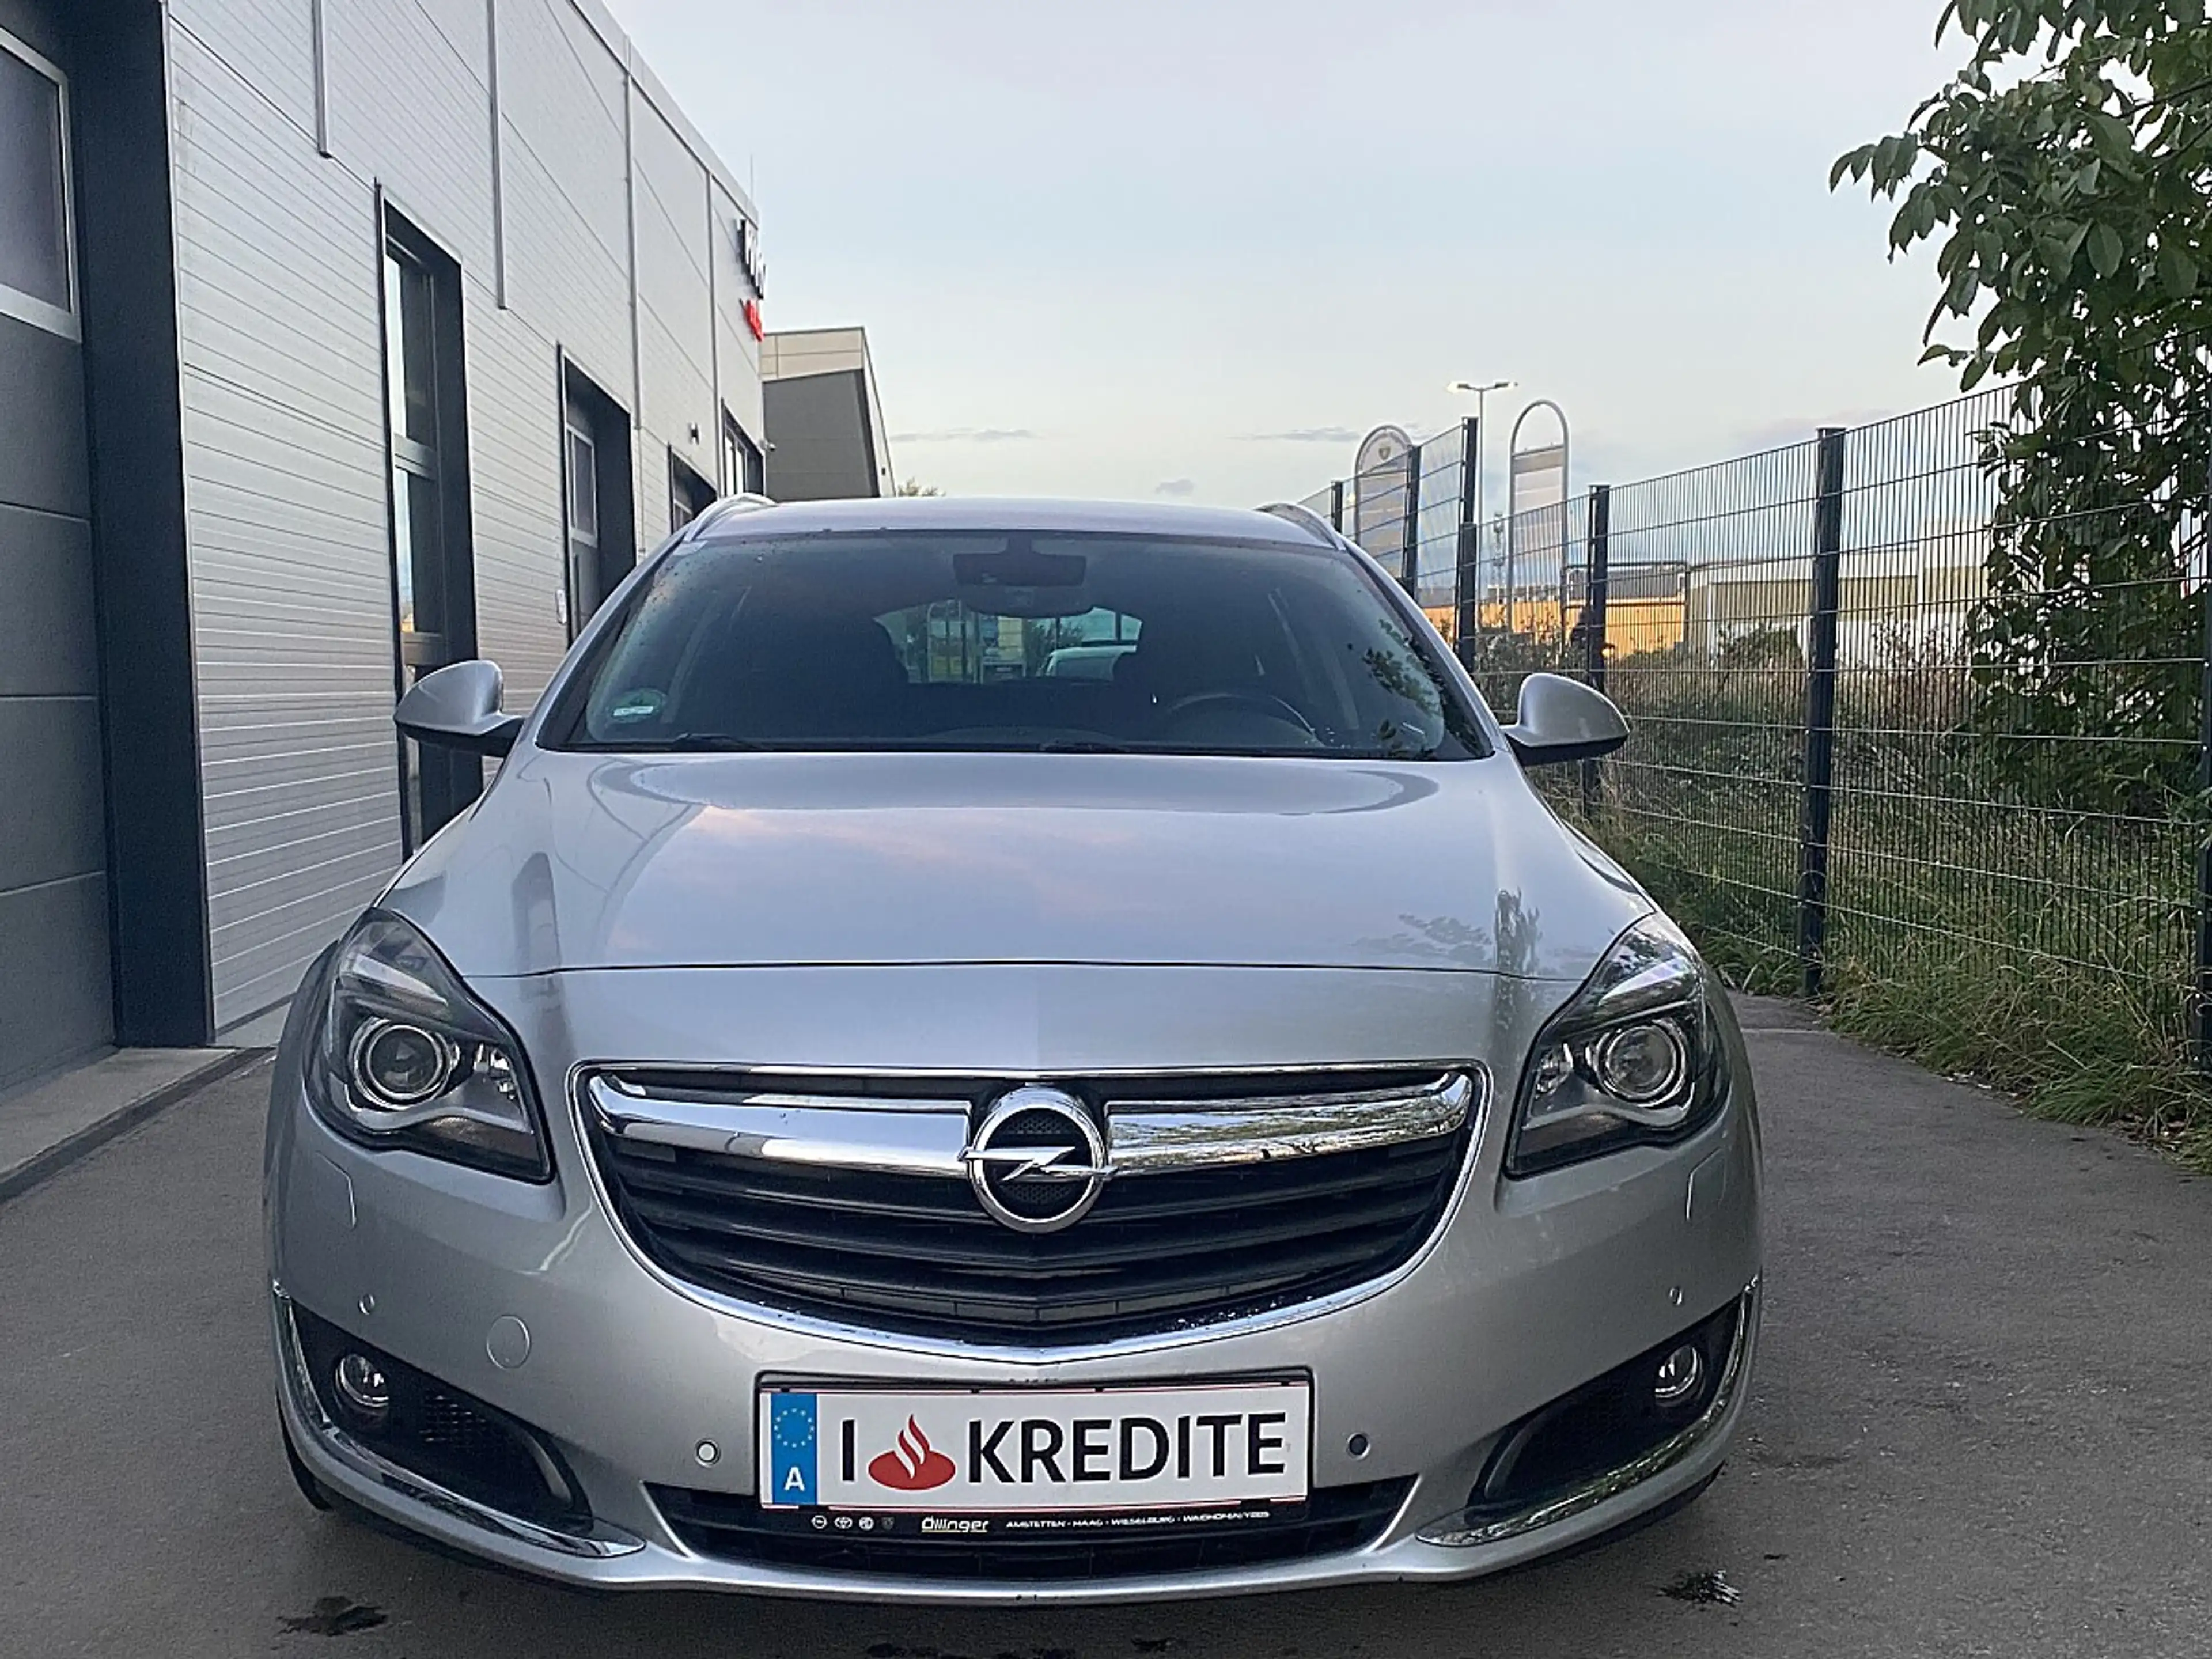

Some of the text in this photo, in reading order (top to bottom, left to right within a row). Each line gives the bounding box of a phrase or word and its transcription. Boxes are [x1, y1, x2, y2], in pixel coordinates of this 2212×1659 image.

[842, 1412, 1286, 1483] I KREDITE
[784, 1466, 805, 1491] A
